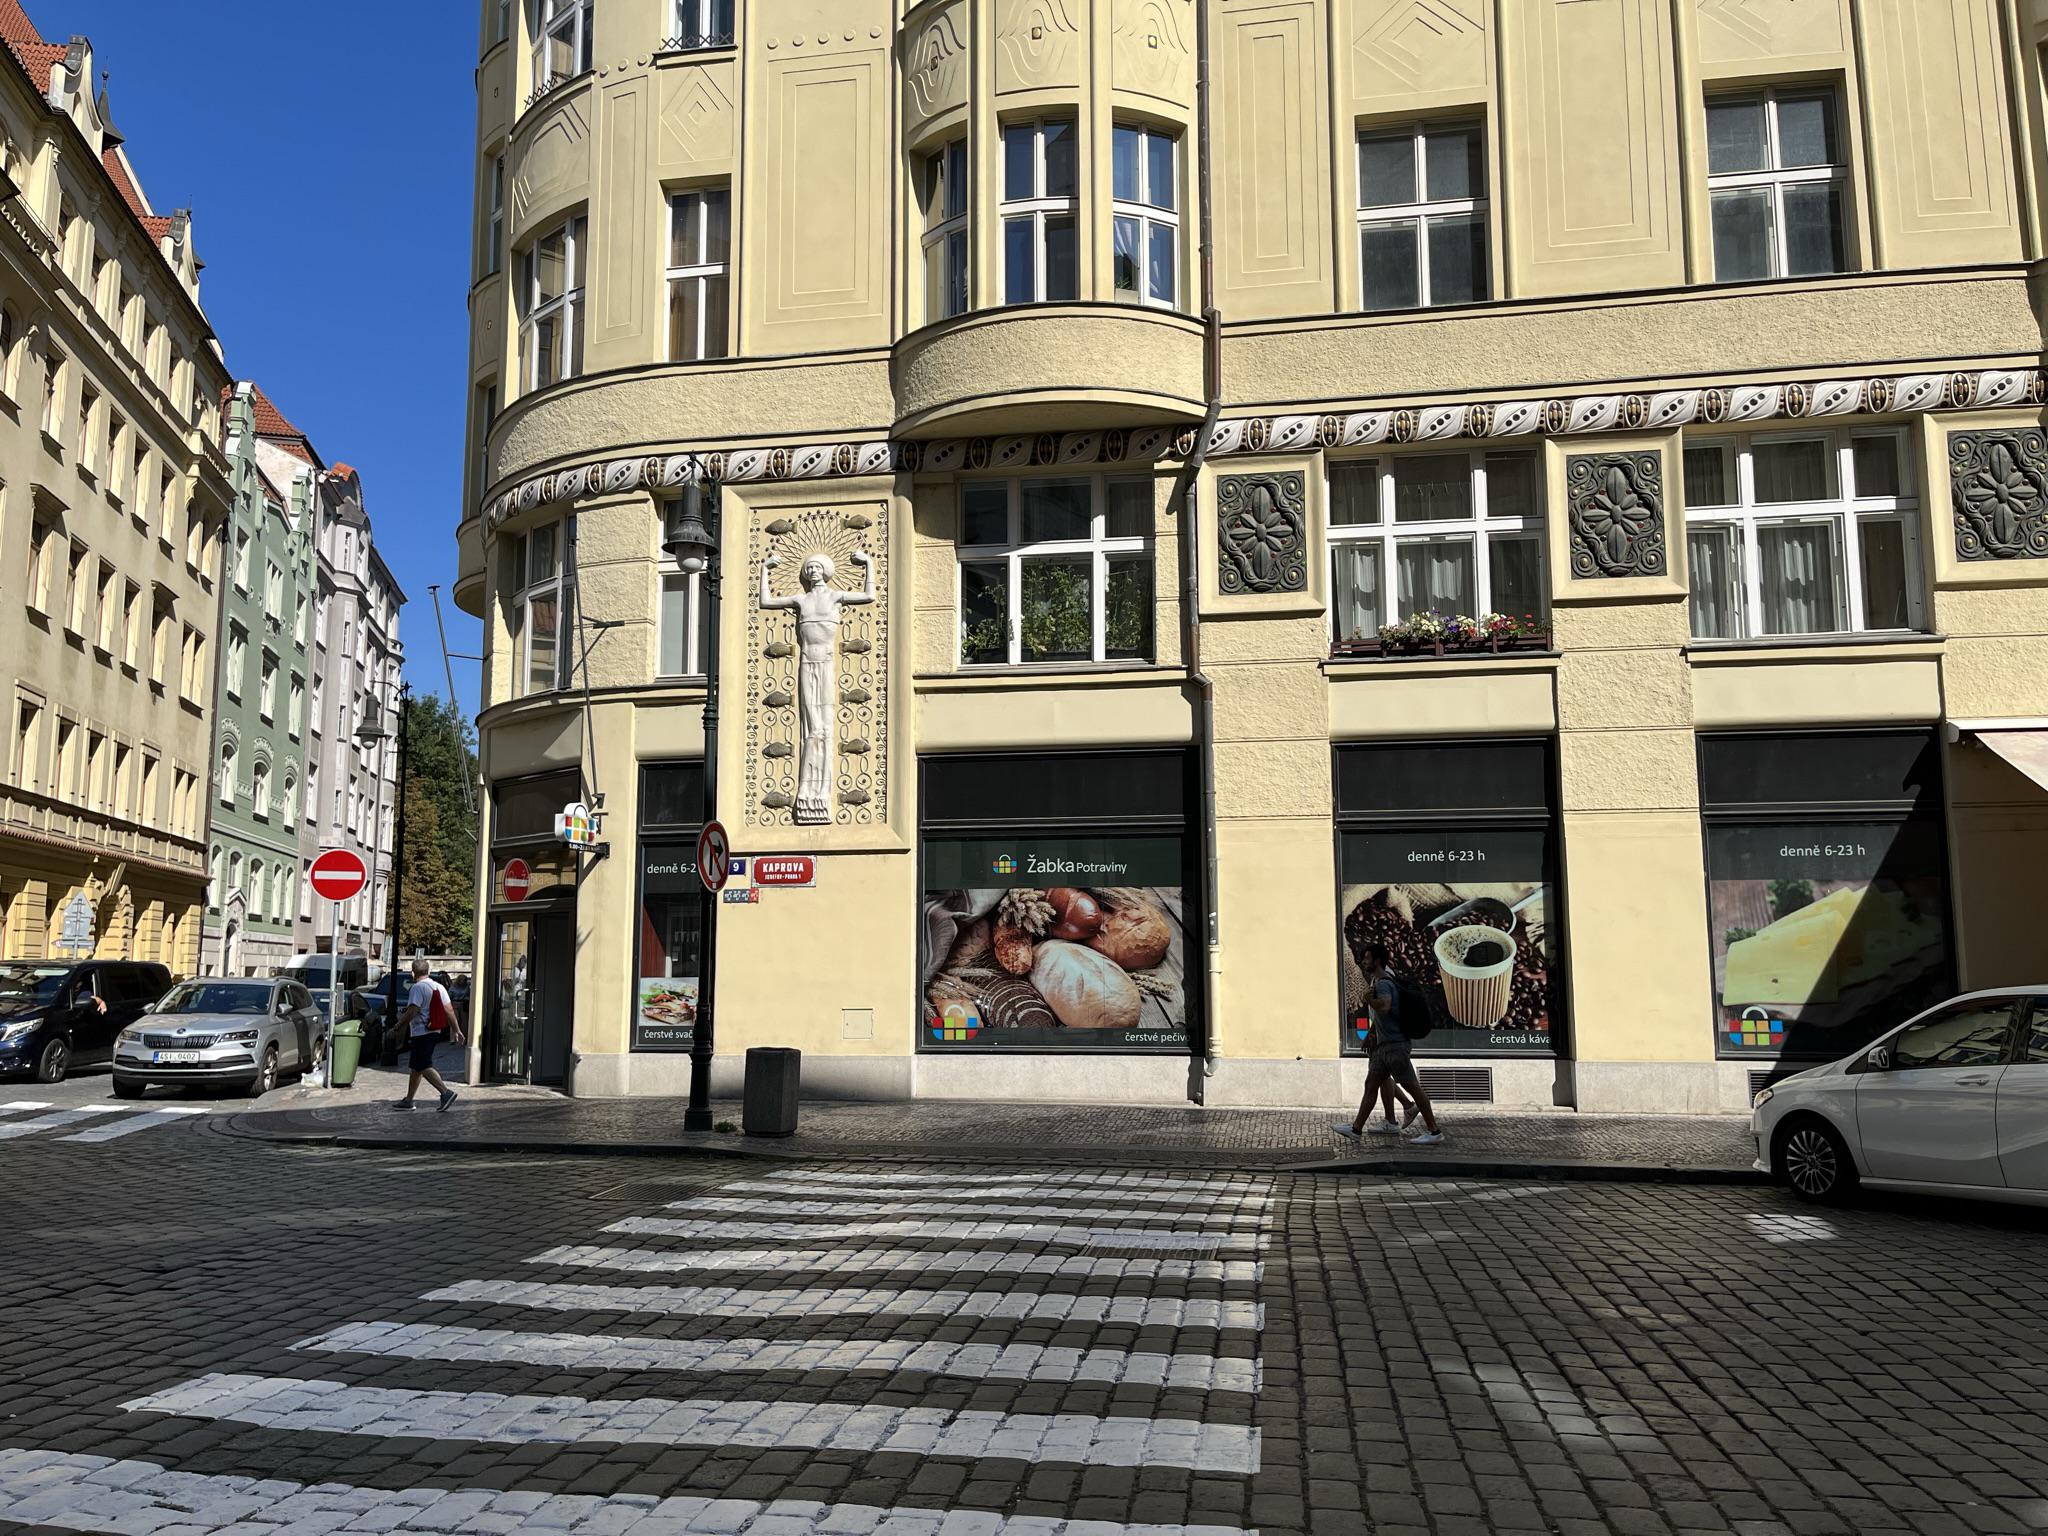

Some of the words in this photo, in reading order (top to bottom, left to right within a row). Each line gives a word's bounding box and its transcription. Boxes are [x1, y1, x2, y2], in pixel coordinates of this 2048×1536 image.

[1407, 850, 1445, 862] denně
[1448, 850, 1474, 861] 6-23
[1477, 849, 1485, 861] h
[1780, 844, 1821, 857] denně
[1824, 844, 1853, 856] 6-23
[1857, 843, 1866, 856] h
[646, 862, 679, 874] denně
[732, 862, 740, 872] 9
[762, 862, 804, 873] KAPROVA
[1026, 854, 1075, 873] Žabka
[1076, 862, 1127, 875] Potraviny
[644, 1029, 674, 1039] čerstvé
[1125, 1032, 1159, 1042] čerstvé
[1490, 1034, 1527, 1044] čerstvá
